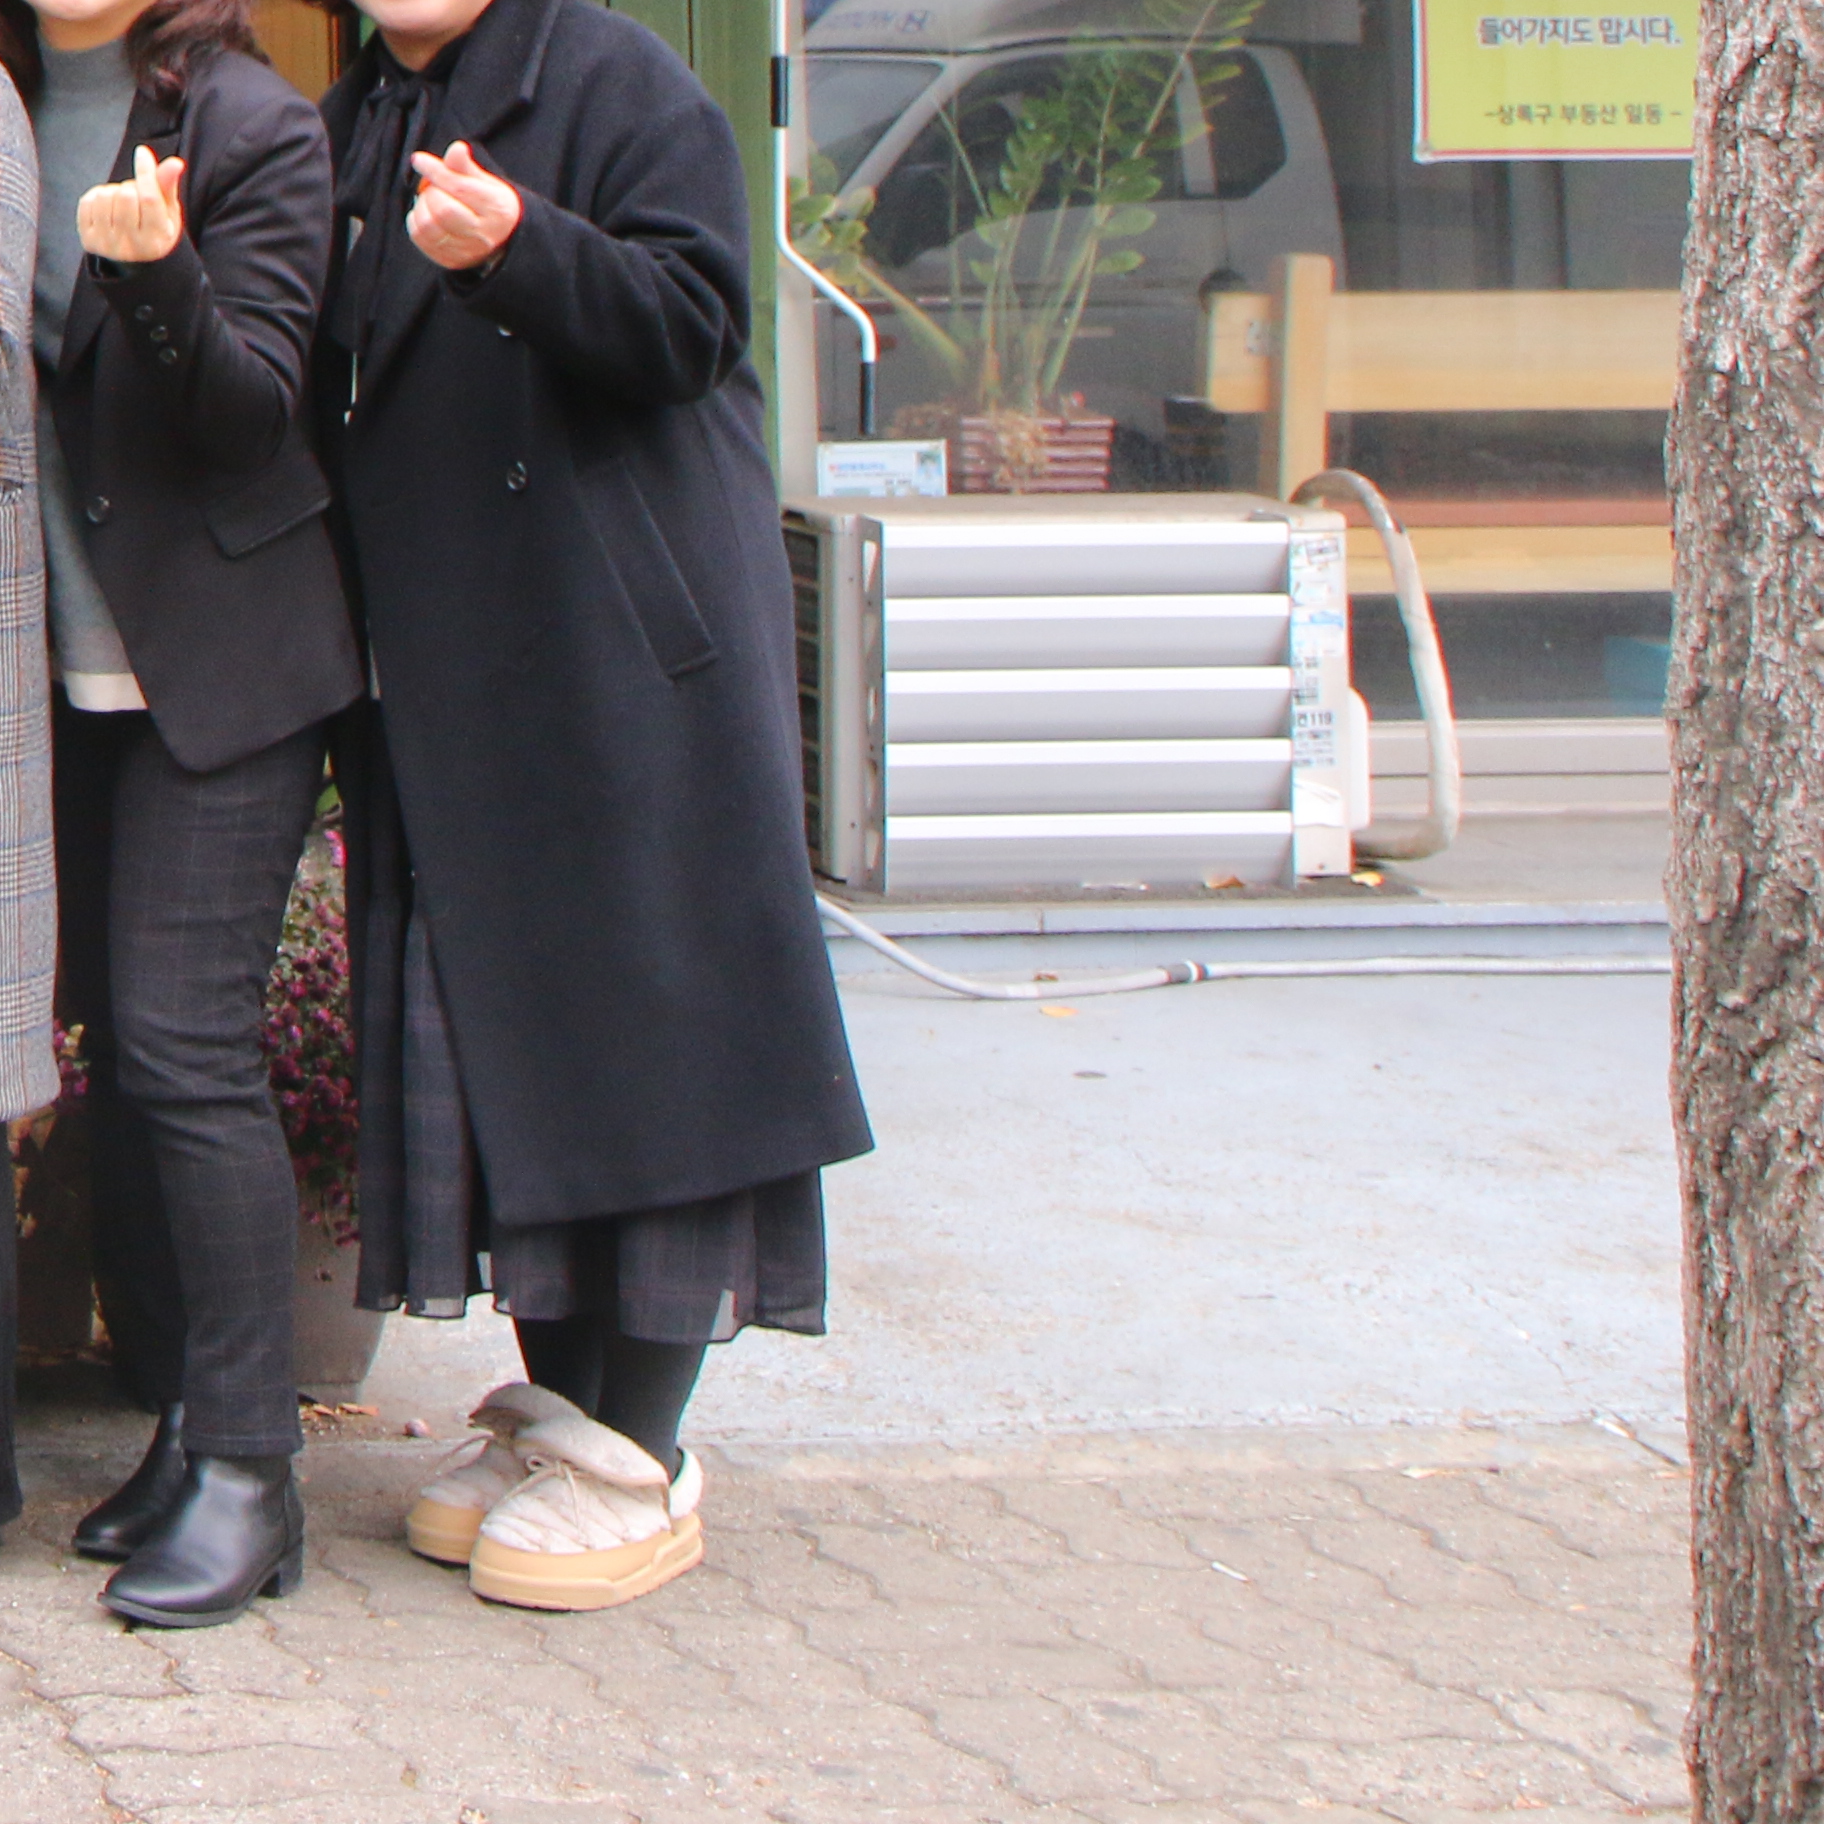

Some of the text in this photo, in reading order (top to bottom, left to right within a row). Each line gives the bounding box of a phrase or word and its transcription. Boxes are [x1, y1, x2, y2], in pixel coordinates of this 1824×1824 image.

[1478, 16, 1683, 46] 들어가지도 맙시다.
[1560, 103, 1618, 126] 부동산
[1623, 103, 1663, 126] 일동
